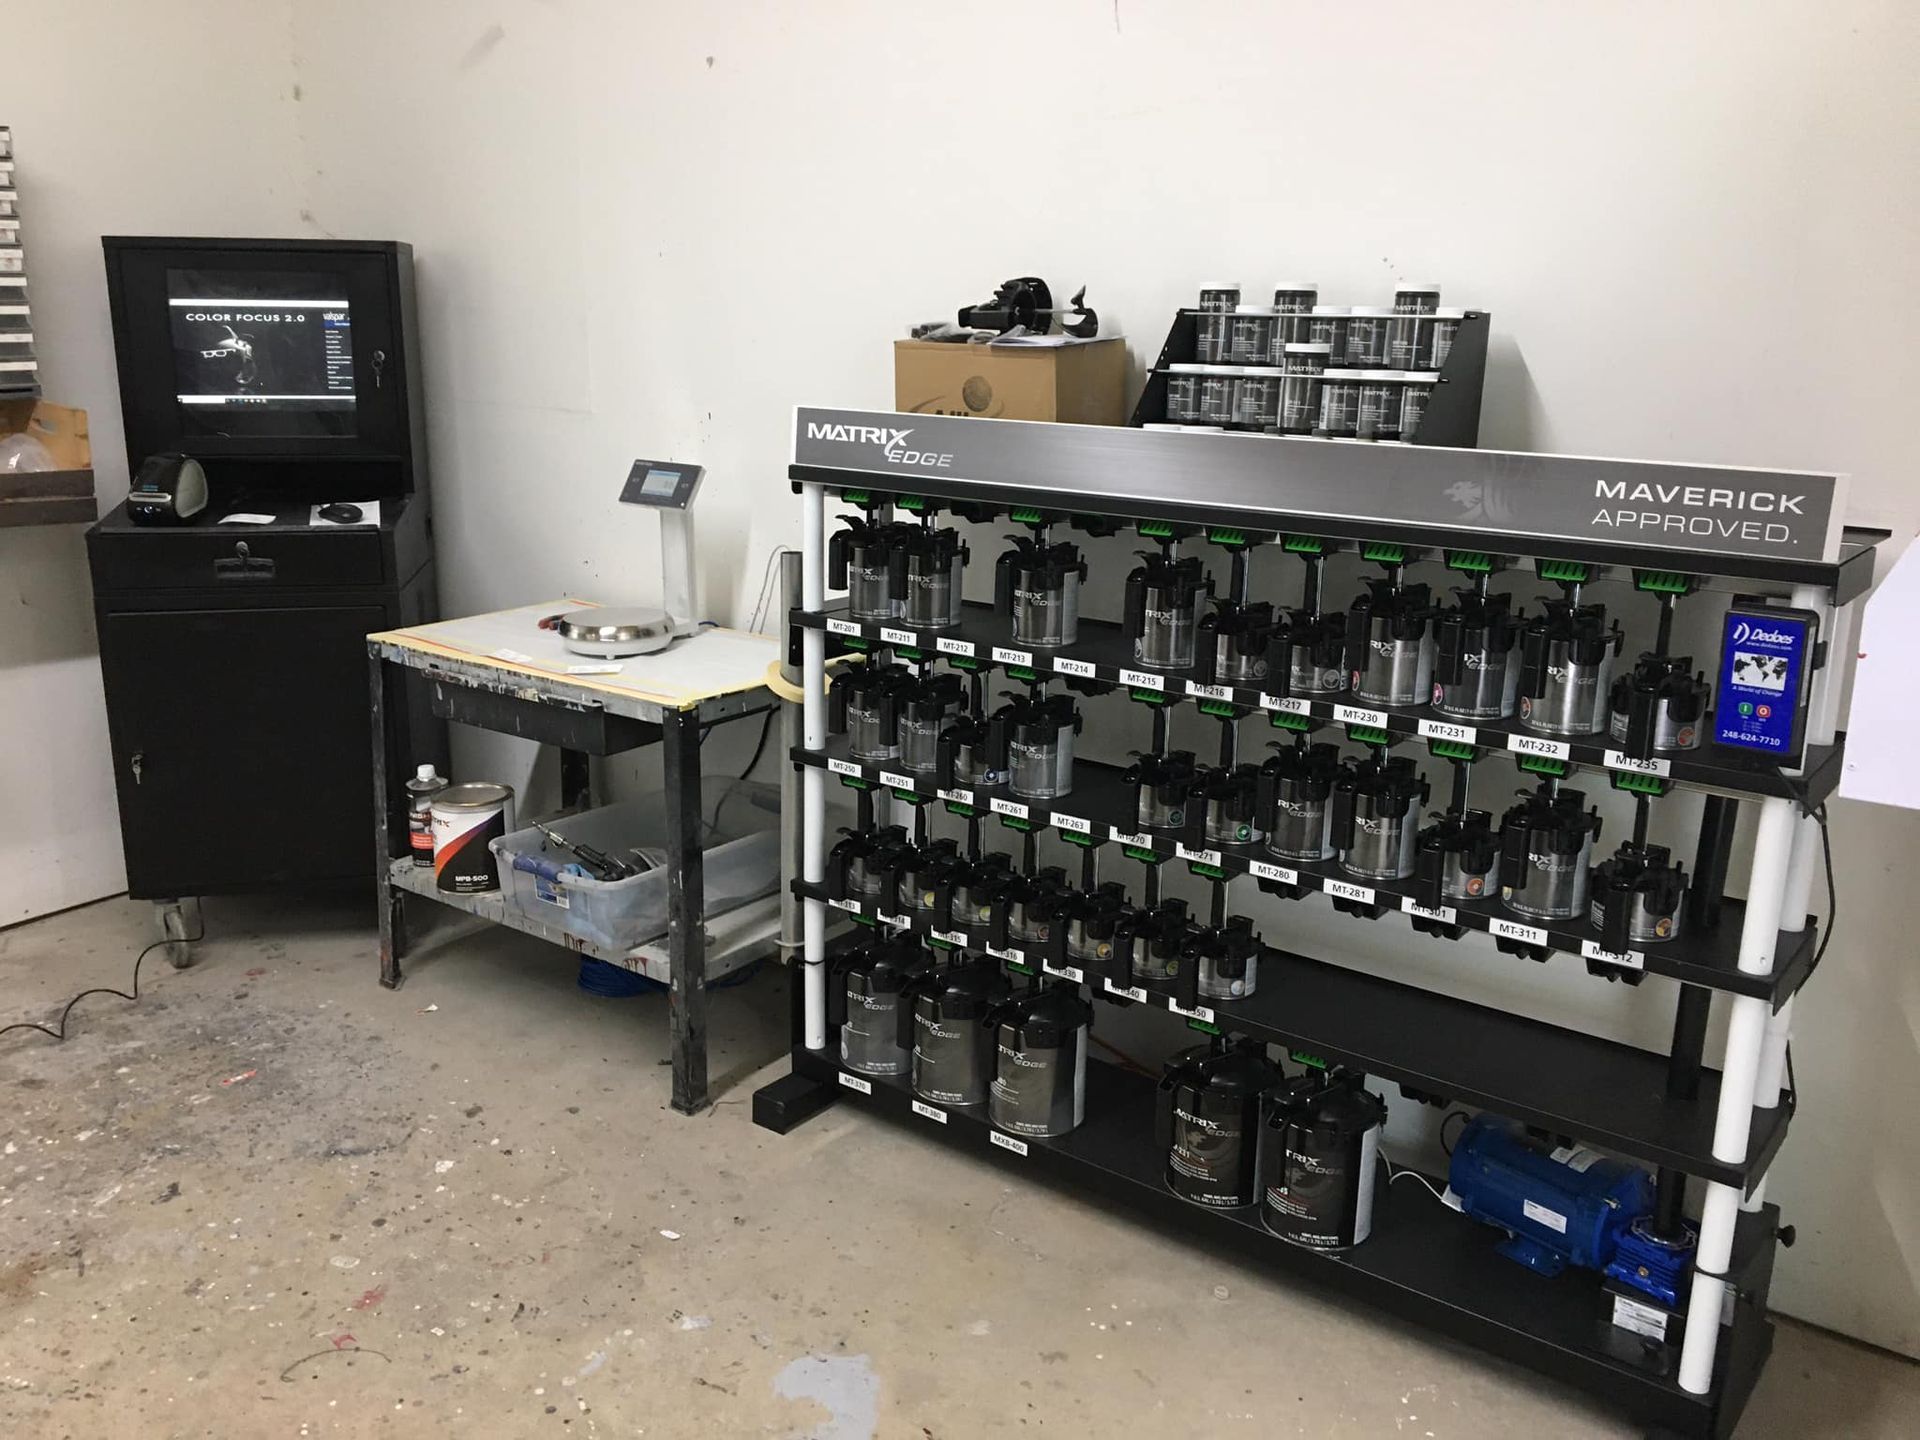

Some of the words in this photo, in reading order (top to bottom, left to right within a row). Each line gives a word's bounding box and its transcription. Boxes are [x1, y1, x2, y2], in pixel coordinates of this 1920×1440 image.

[236, 314, 280, 322] FOCUS
[323, 311, 345, 322] valspar
[808, 422, 915, 454] MATRIX
[887, 449, 953, 468] EDGE
[1594, 479, 1806, 515] MAVERICK
[1592, 509, 1798, 544] APPROVED.
[833, 622, 855, 633] MT-201
[887, 633, 910, 642] MT-211
[1750, 629, 1795, 644] Dedoes
[944, 642, 968, 653] MT-212
[1000, 651, 1025, 662] MT-213
[1061, 661, 1088, 674] MT-214
[1128, 673, 1156, 685] MT-215
[1194, 683, 1224, 697] MT-216
[1738, 686, 1755, 694] World
[1269, 697, 1301, 711] MT-217
[1343, 709, 1378, 723] MT-230
[1428, 724, 1464, 738] MT-231
[1722, 730, 1780, 746] 248-624-7710
[1518, 739, 1558, 755] MT-232
[834, 762, 856, 773] MT-250
[1616, 756, 1658, 771] MT-235
[886, 776, 909, 787] MT-251
[997, 802, 1022, 814] MT-261
[1057, 816, 1084, 830] MT-263
[1258, 866, 1291, 880] MT-280
[1332, 883, 1366, 898] MT-281
[1499, 924, 1537, 940] MT-311
[844, 1076, 866, 1090] MT-370
[919, 1104, 942, 1119] MT-380
[995, 1133, 1025, 1153] MXB-400
